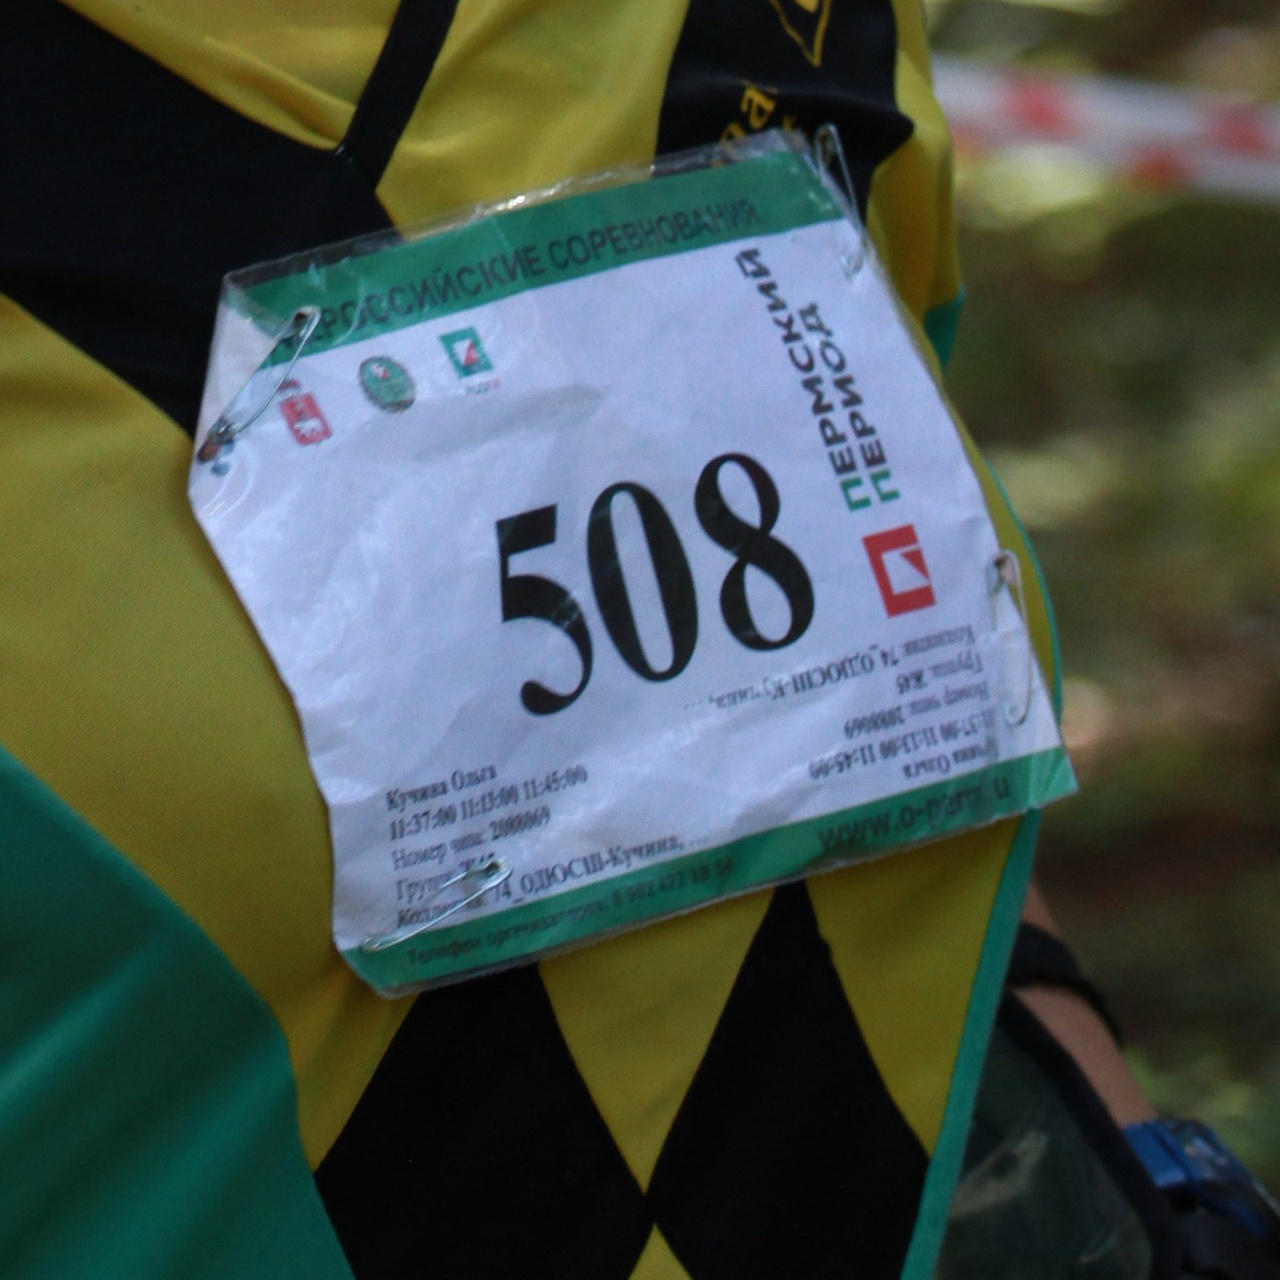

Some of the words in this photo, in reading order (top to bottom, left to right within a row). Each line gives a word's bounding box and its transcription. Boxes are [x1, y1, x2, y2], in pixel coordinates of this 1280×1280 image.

[280, 246, 544, 348] РОССИЙСКИЕ
[548, 198, 761, 270] СОРЕВНОВАНИЯ
[735, 248, 873, 512] ПЕРМСКИЙ
[798, 301, 901, 503] ПЕРИОД
[495, 451, 815, 717] 508
[386, 780, 448, 813] Кучина
[451, 764, 497, 791] Ольга
[391, 842, 447, 871] Номер
[817, 777, 1012, 848] www.o-permu
